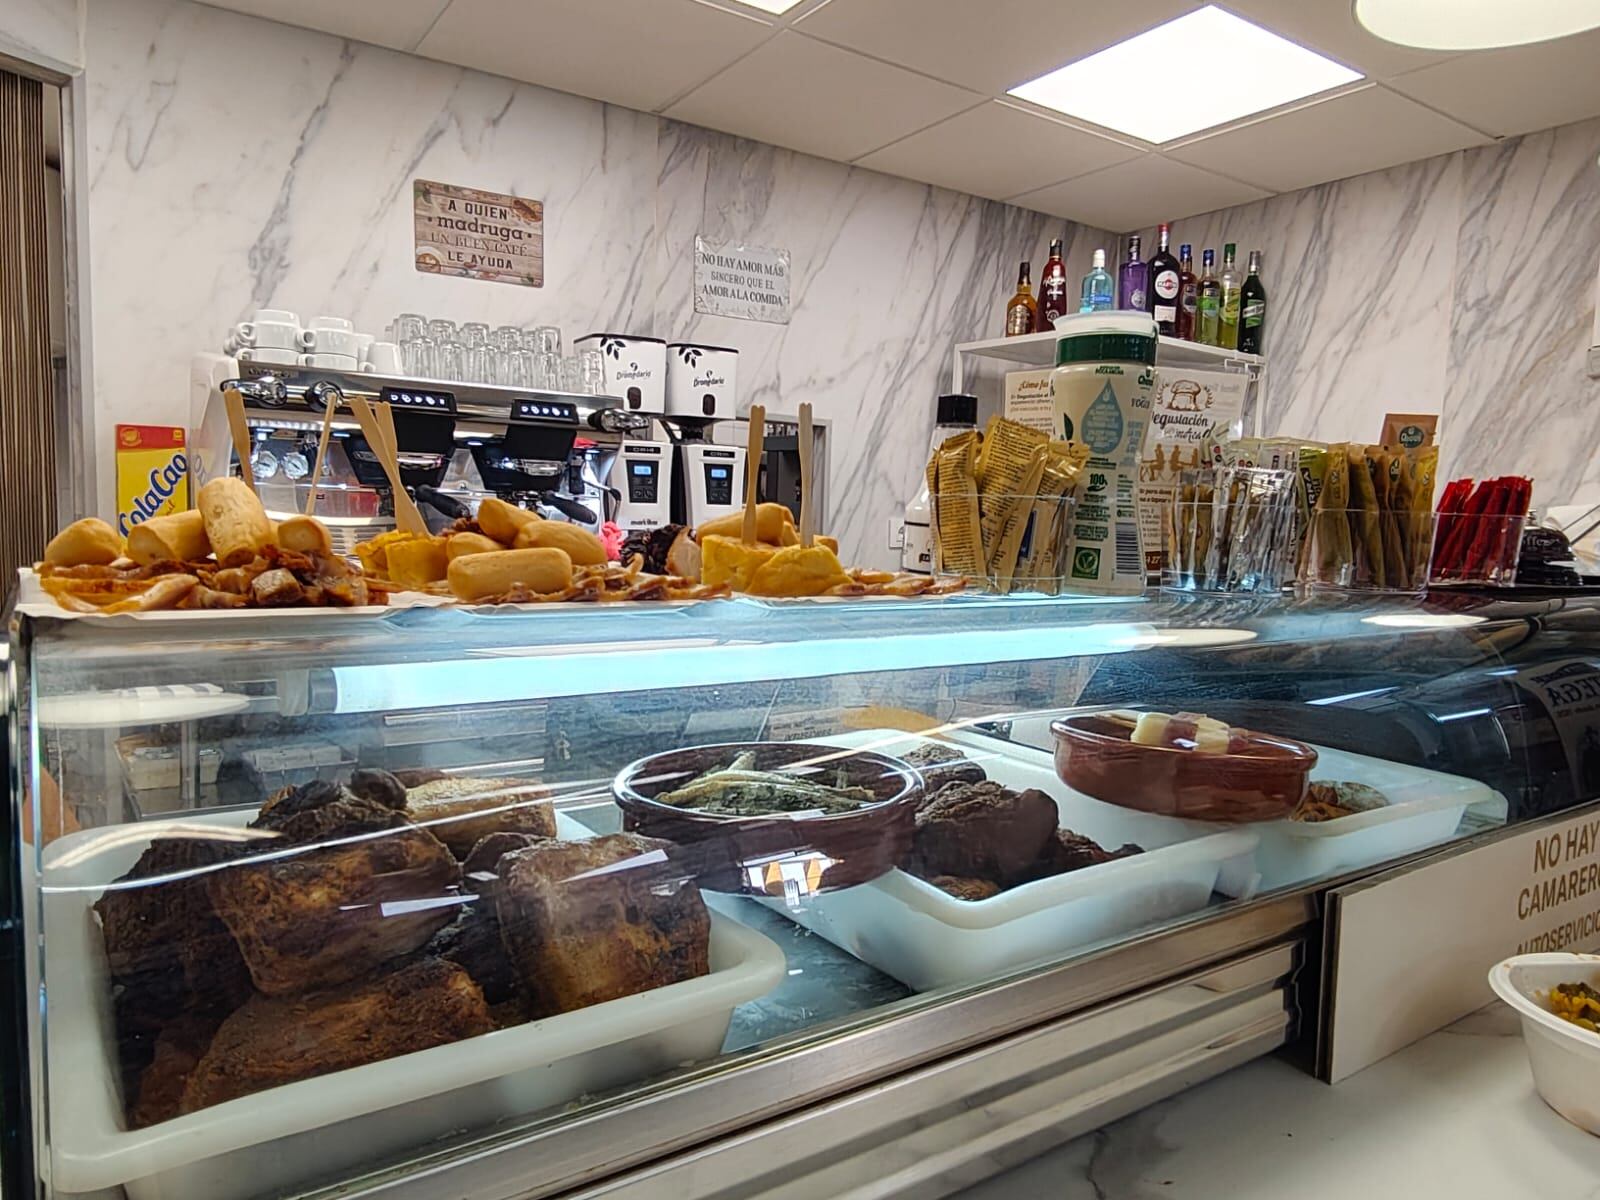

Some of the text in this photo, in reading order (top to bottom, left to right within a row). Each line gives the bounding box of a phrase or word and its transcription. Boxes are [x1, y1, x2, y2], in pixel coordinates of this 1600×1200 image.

[448, 200, 507, 220] A QUIEN
[436, 216, 523, 242] madruga
[431, 232, 528, 256] UN BUEN CAFÉ
[448, 250, 513, 270] LE AYUDA
[702, 253, 784, 277] NO HAY AMOR MÁS
[711, 271, 775, 290] SINCERO QUE EL
[702, 284, 783, 307] AMOR A LA COMIDA
[1152, 411, 1209, 430] egustación
[119, 454, 188, 538] ColaCao
[1534, 820, 1600, 874] NO HAY
[1518, 862, 1600, 920] CAMARER
